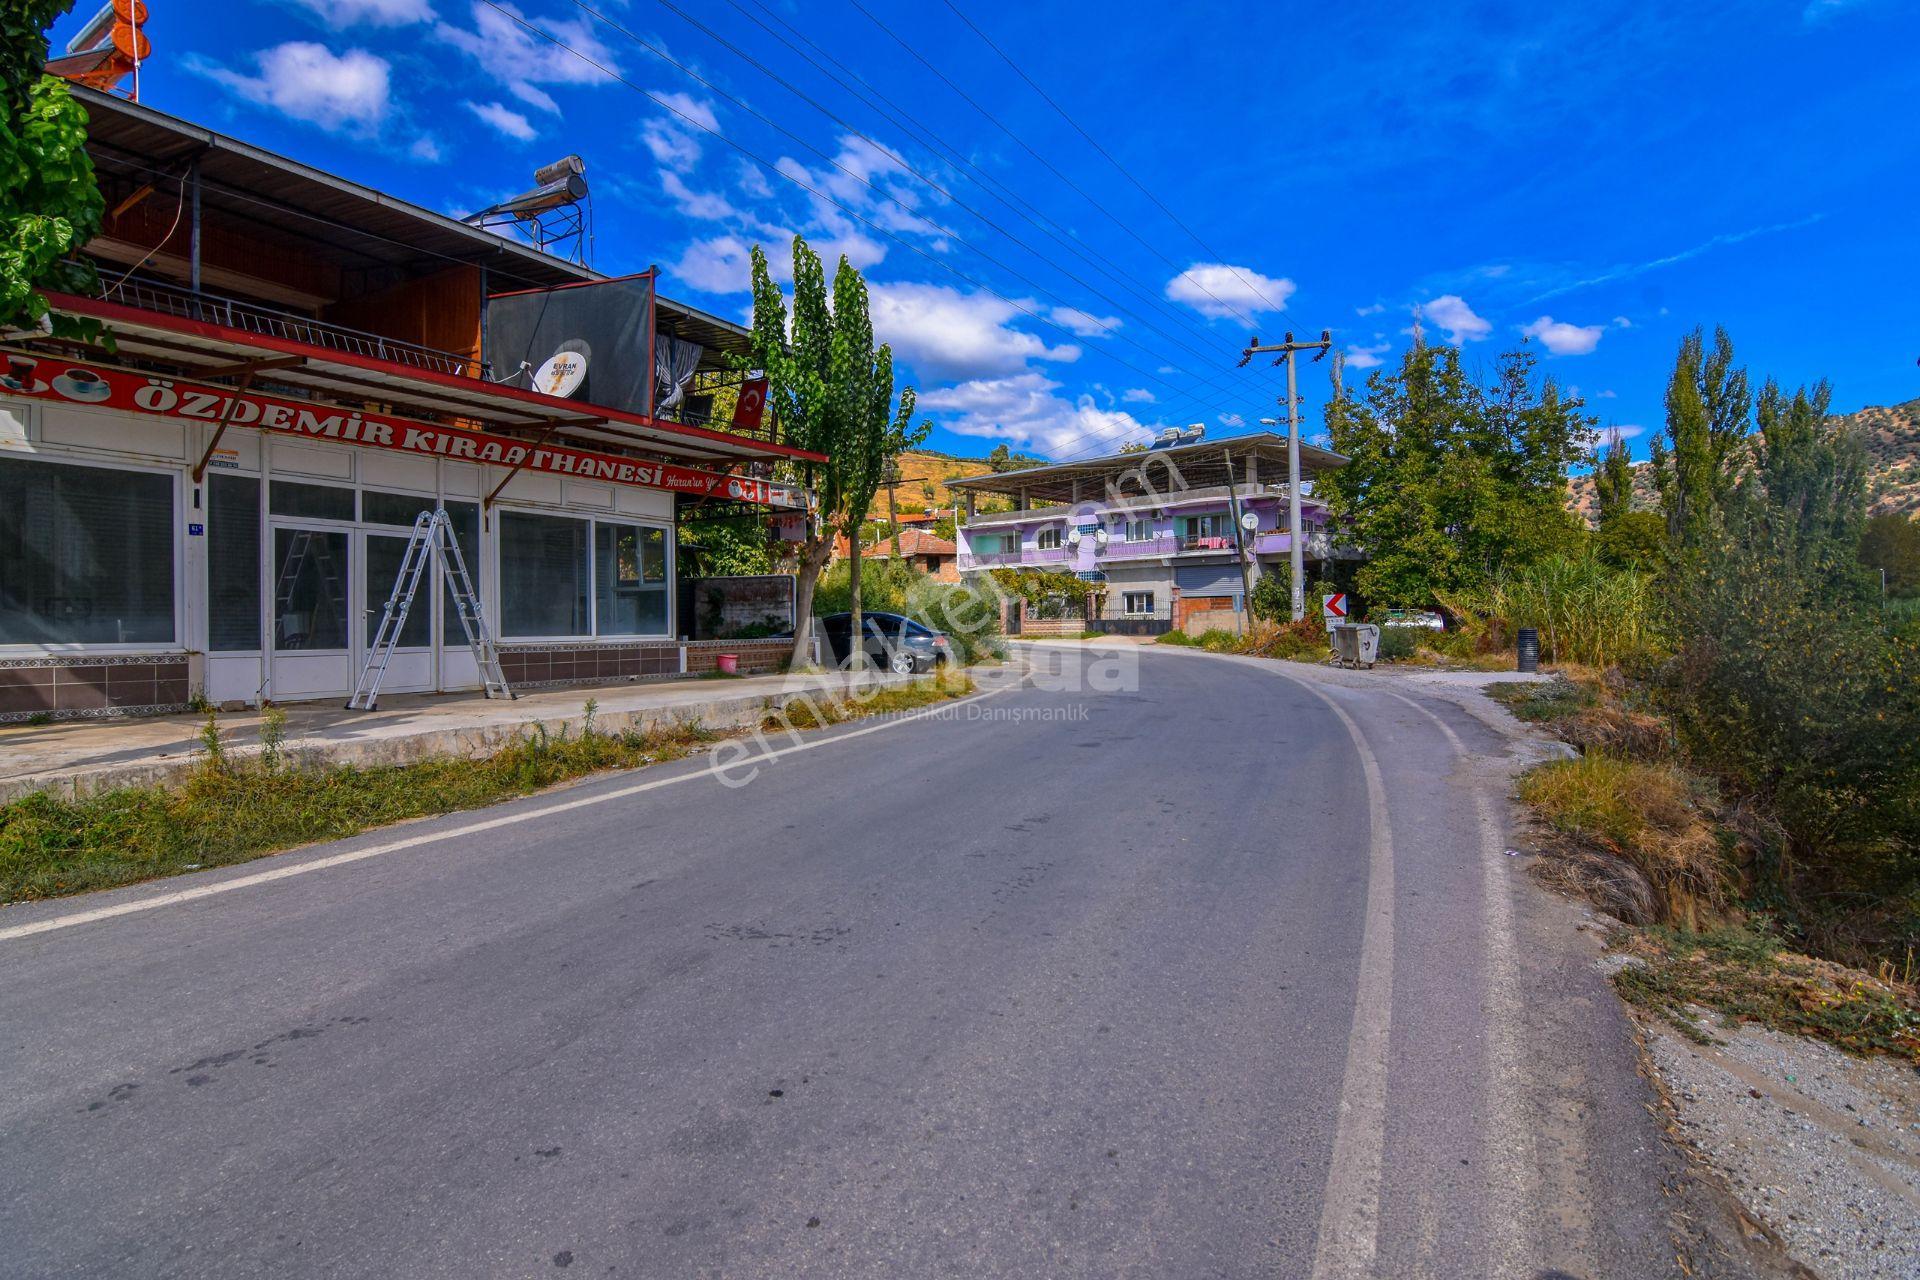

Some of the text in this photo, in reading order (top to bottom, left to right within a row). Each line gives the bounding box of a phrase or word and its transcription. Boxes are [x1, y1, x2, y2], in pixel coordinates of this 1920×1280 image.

[553, 362, 577, 370] EVRAN
[134, 379, 665, 486] ÖZDEMİR KIRAATHANESİ
